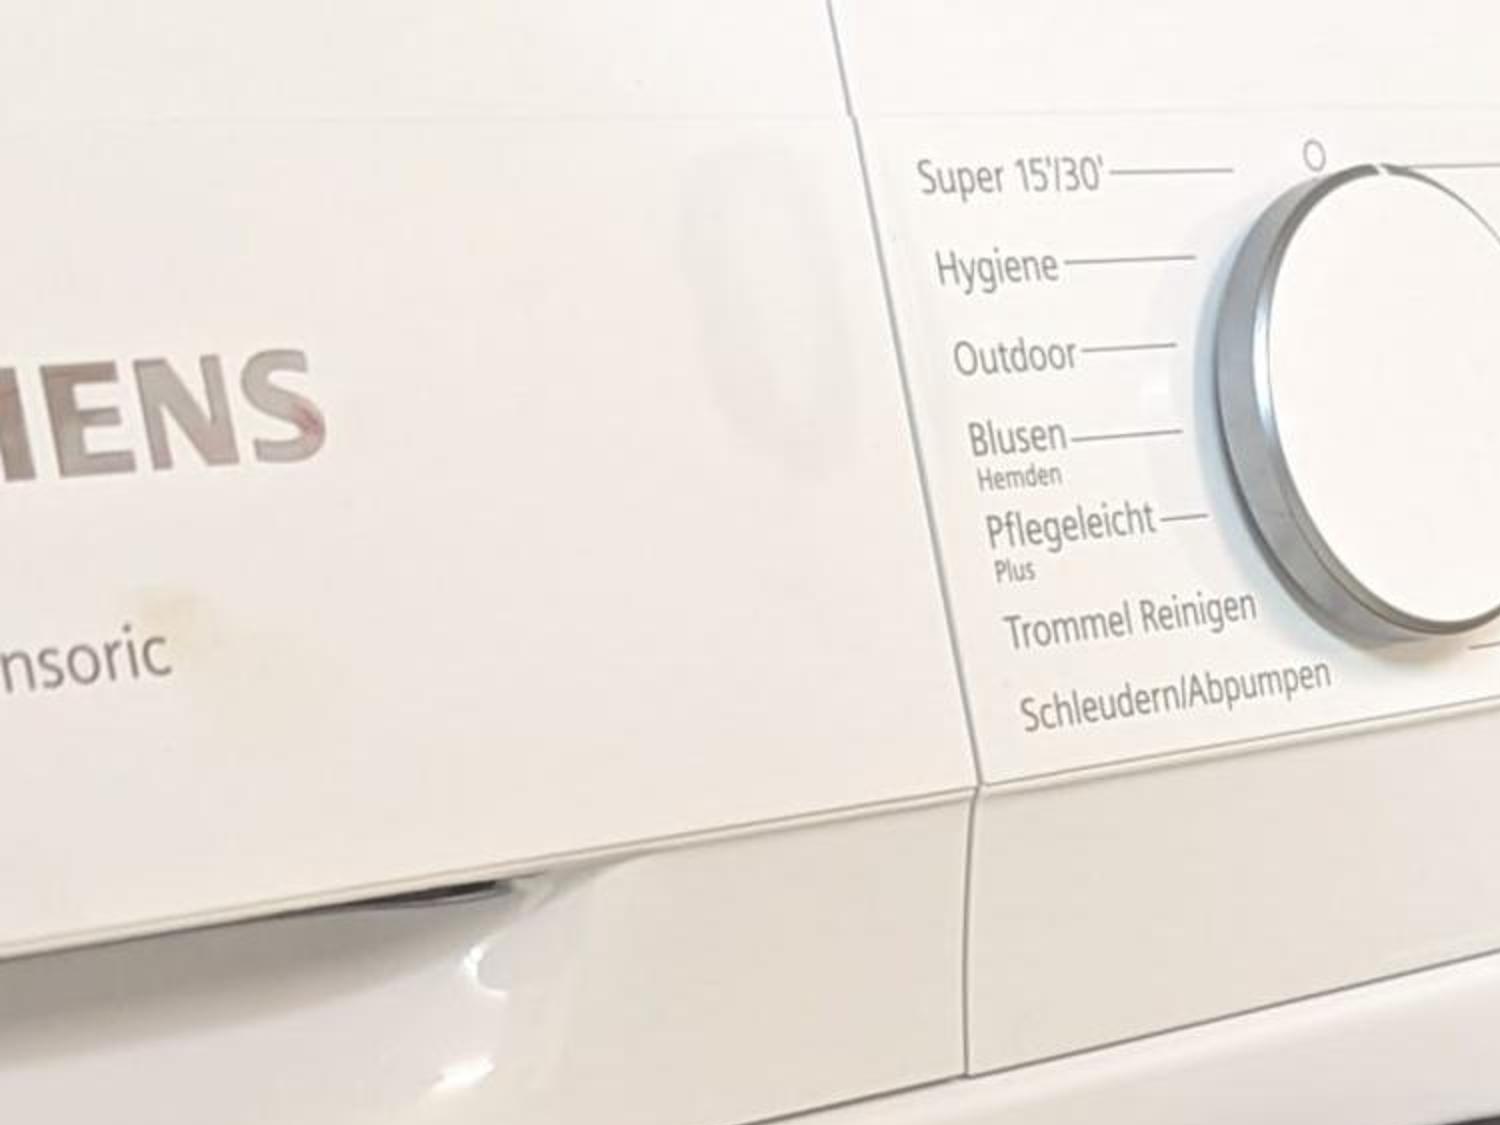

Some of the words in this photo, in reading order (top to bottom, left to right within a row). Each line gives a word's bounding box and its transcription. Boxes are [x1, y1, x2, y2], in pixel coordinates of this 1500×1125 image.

[918, 159, 1005, 203] Super
[1014, 154, 1104, 193] 15'/30'
[935, 247, 1060, 295] Hygiene
[953, 336, 1077, 376] Outdoor
[0, 349, 327, 483] IENS
[968, 420, 1068, 457] Blusen
[976, 464, 1063, 492] Hemden
[986, 502, 1157, 554] Pflegeleicht
[994, 558, 1036, 584] Plus
[1003, 601, 1133, 650] Trommel
[1139, 592, 1258, 636] Reinigen
[0, 624, 172, 693] nsoric
[1020, 660, 1333, 732] Schleudern/Abpumpen
